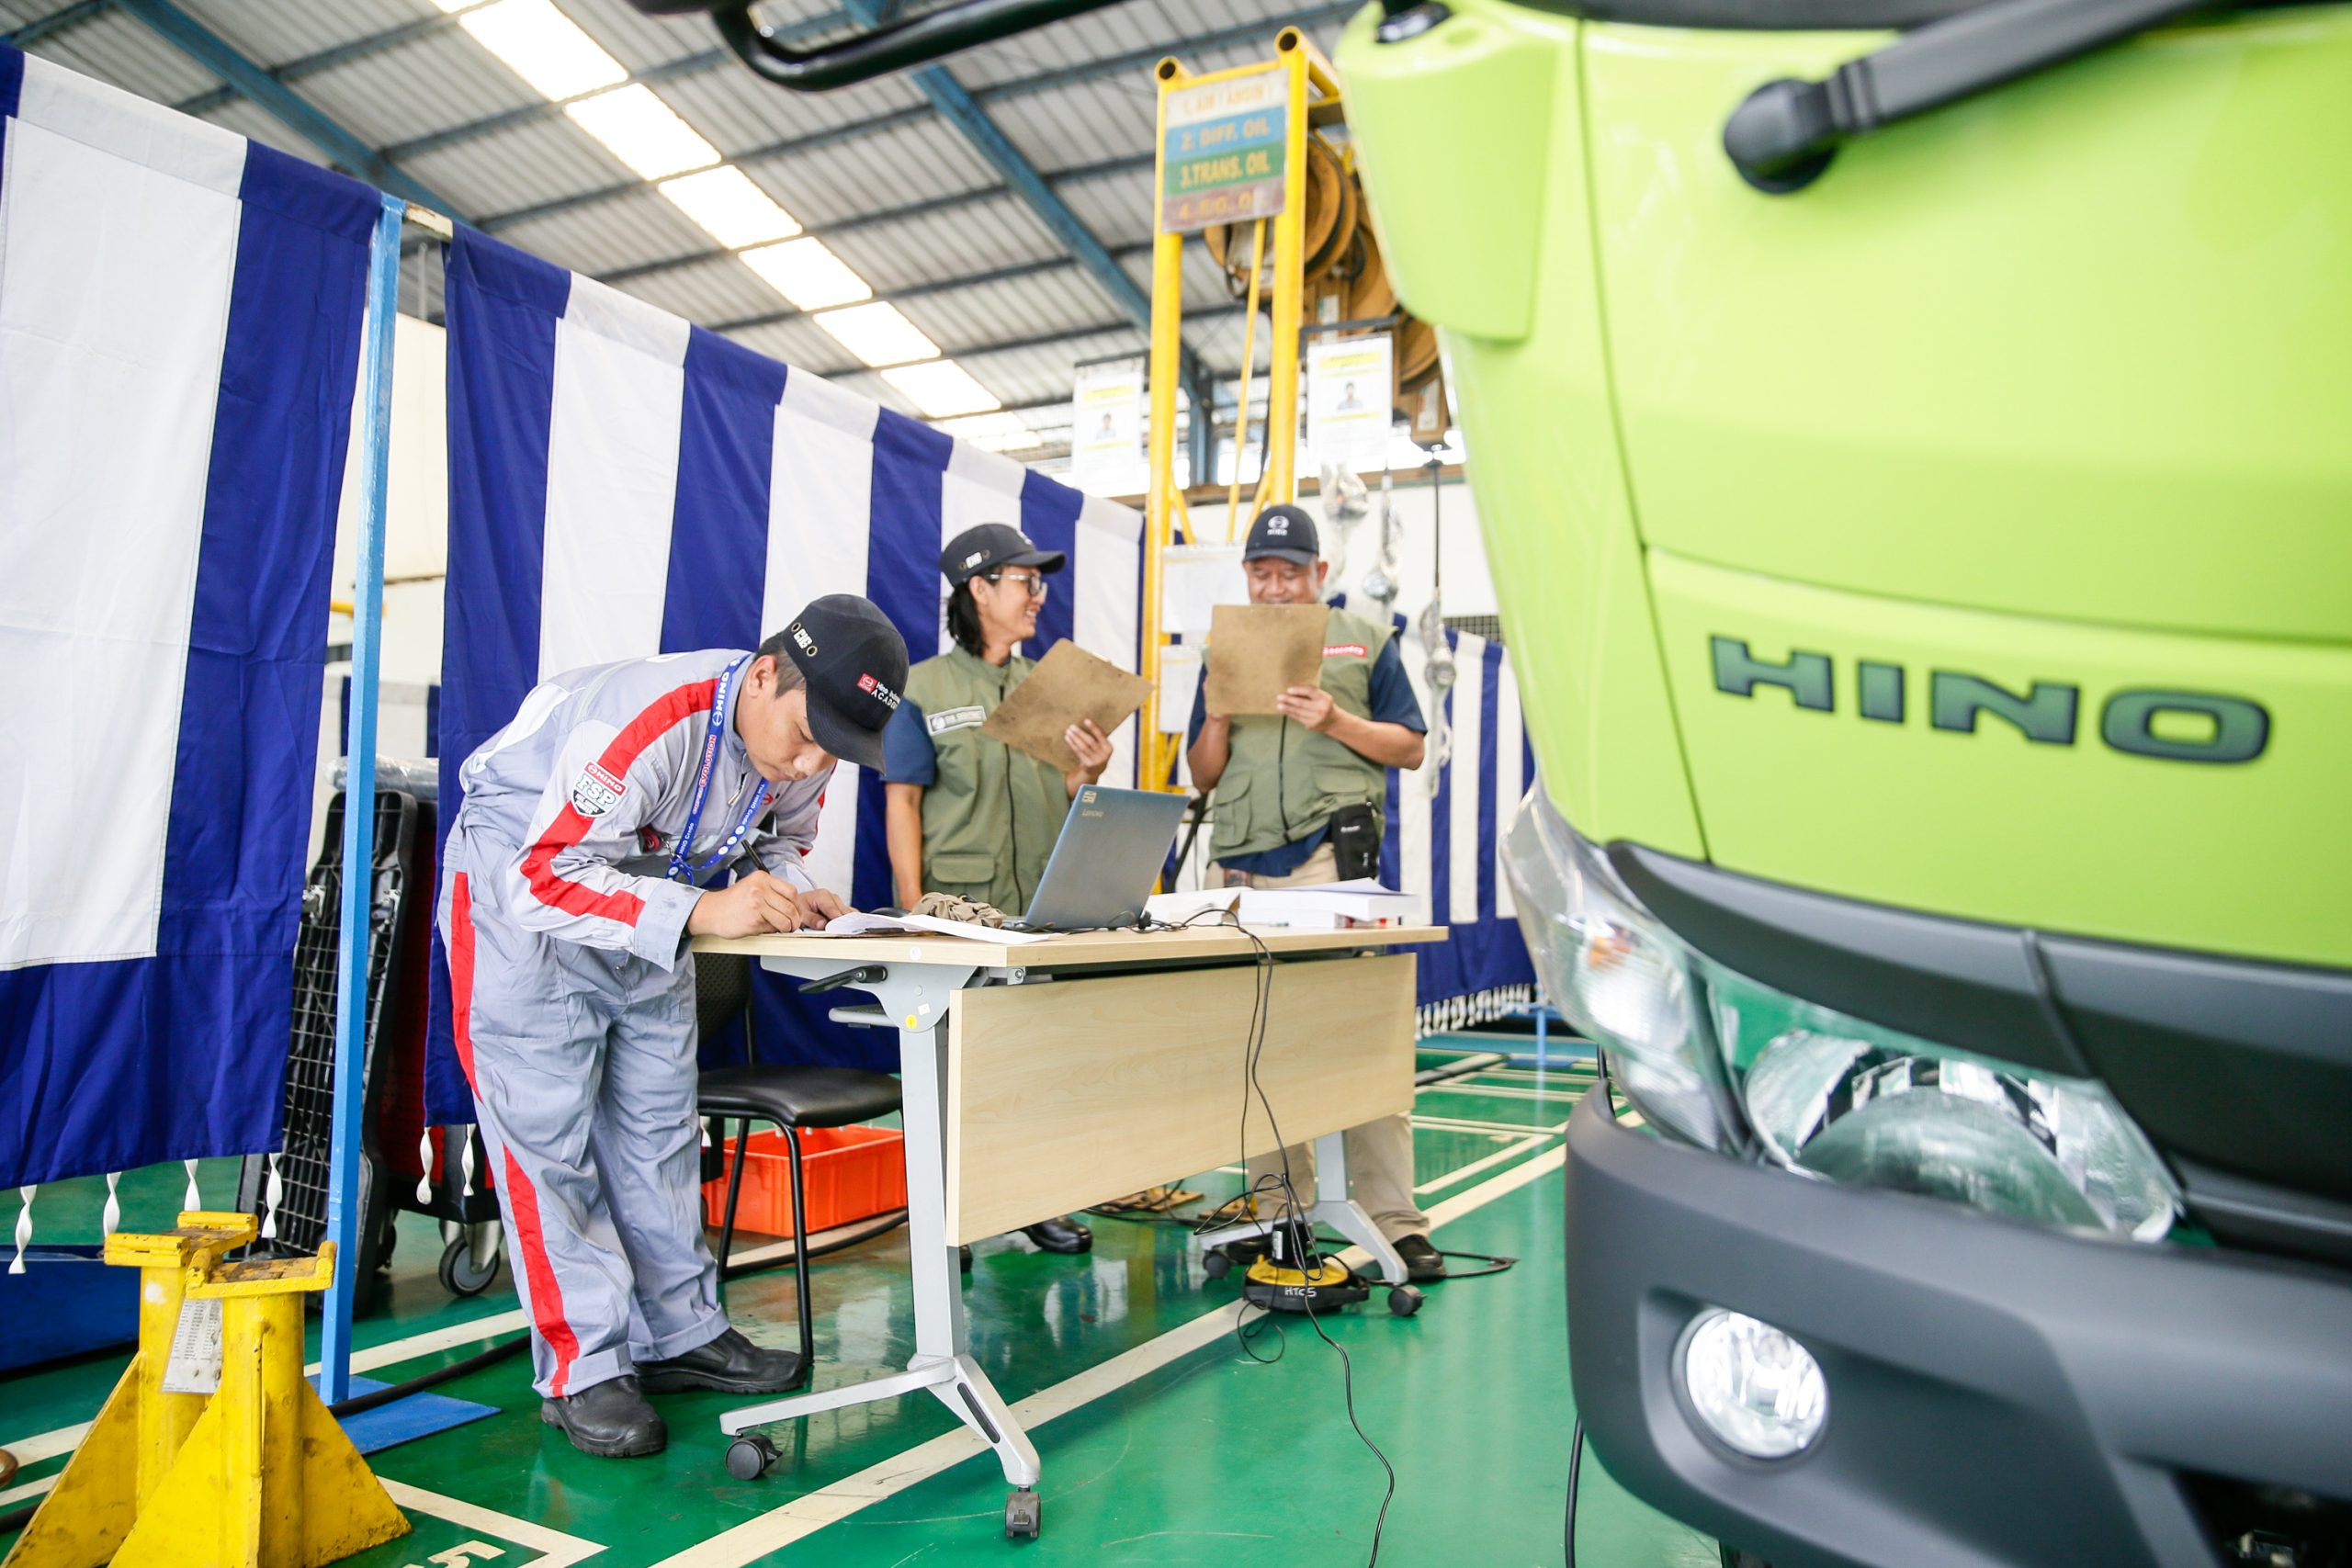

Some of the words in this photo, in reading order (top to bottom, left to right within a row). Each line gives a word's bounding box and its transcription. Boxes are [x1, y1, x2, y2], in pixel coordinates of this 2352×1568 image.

[1242, 117, 1271, 139] OIL
[1245, 149, 1271, 175] OIL
[716, 671, 730, 711] HINO
[1710, 635, 2271, 765] HINO
[699, 734, 717, 788] EVOLUTION
[576, 773, 616, 807] FSP
[596, 772, 623, 792] HINO
